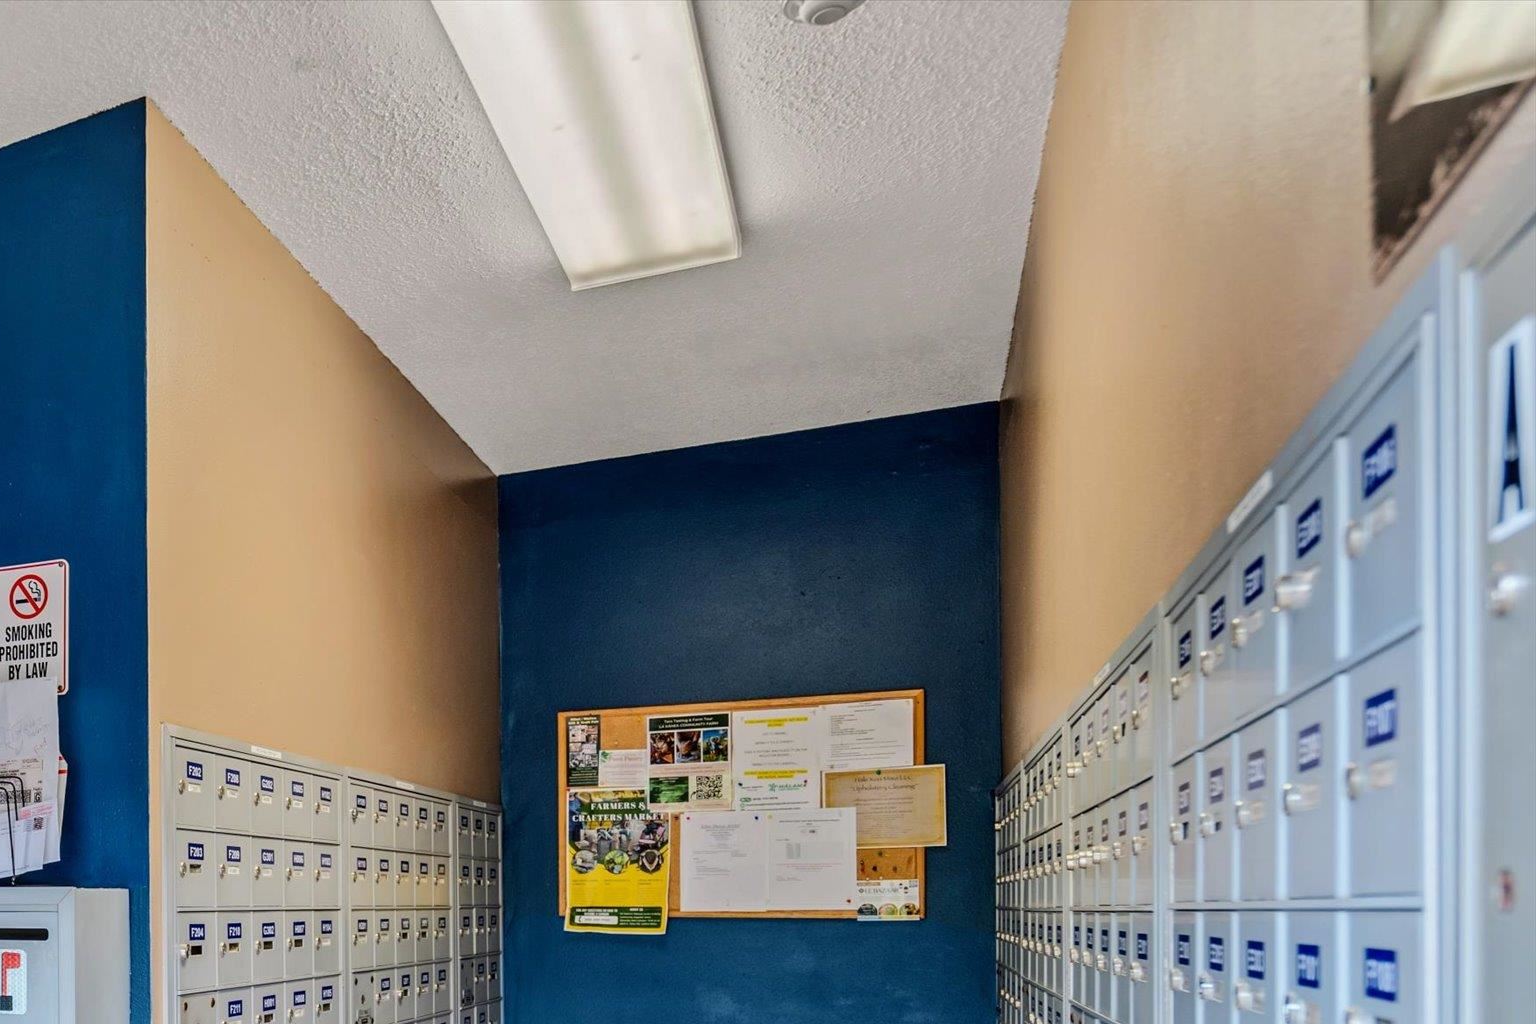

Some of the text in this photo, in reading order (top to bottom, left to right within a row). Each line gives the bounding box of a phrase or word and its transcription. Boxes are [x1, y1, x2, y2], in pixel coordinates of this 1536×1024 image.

[5, 622, 52, 642] SMOKING
[0, 641, 58, 662] PROHIBITED
[8, 662, 48, 680] BY LAW
[591, 802, 645, 811] FARMERS &
[572, 813, 664, 822] CRAFTERS MARKET
